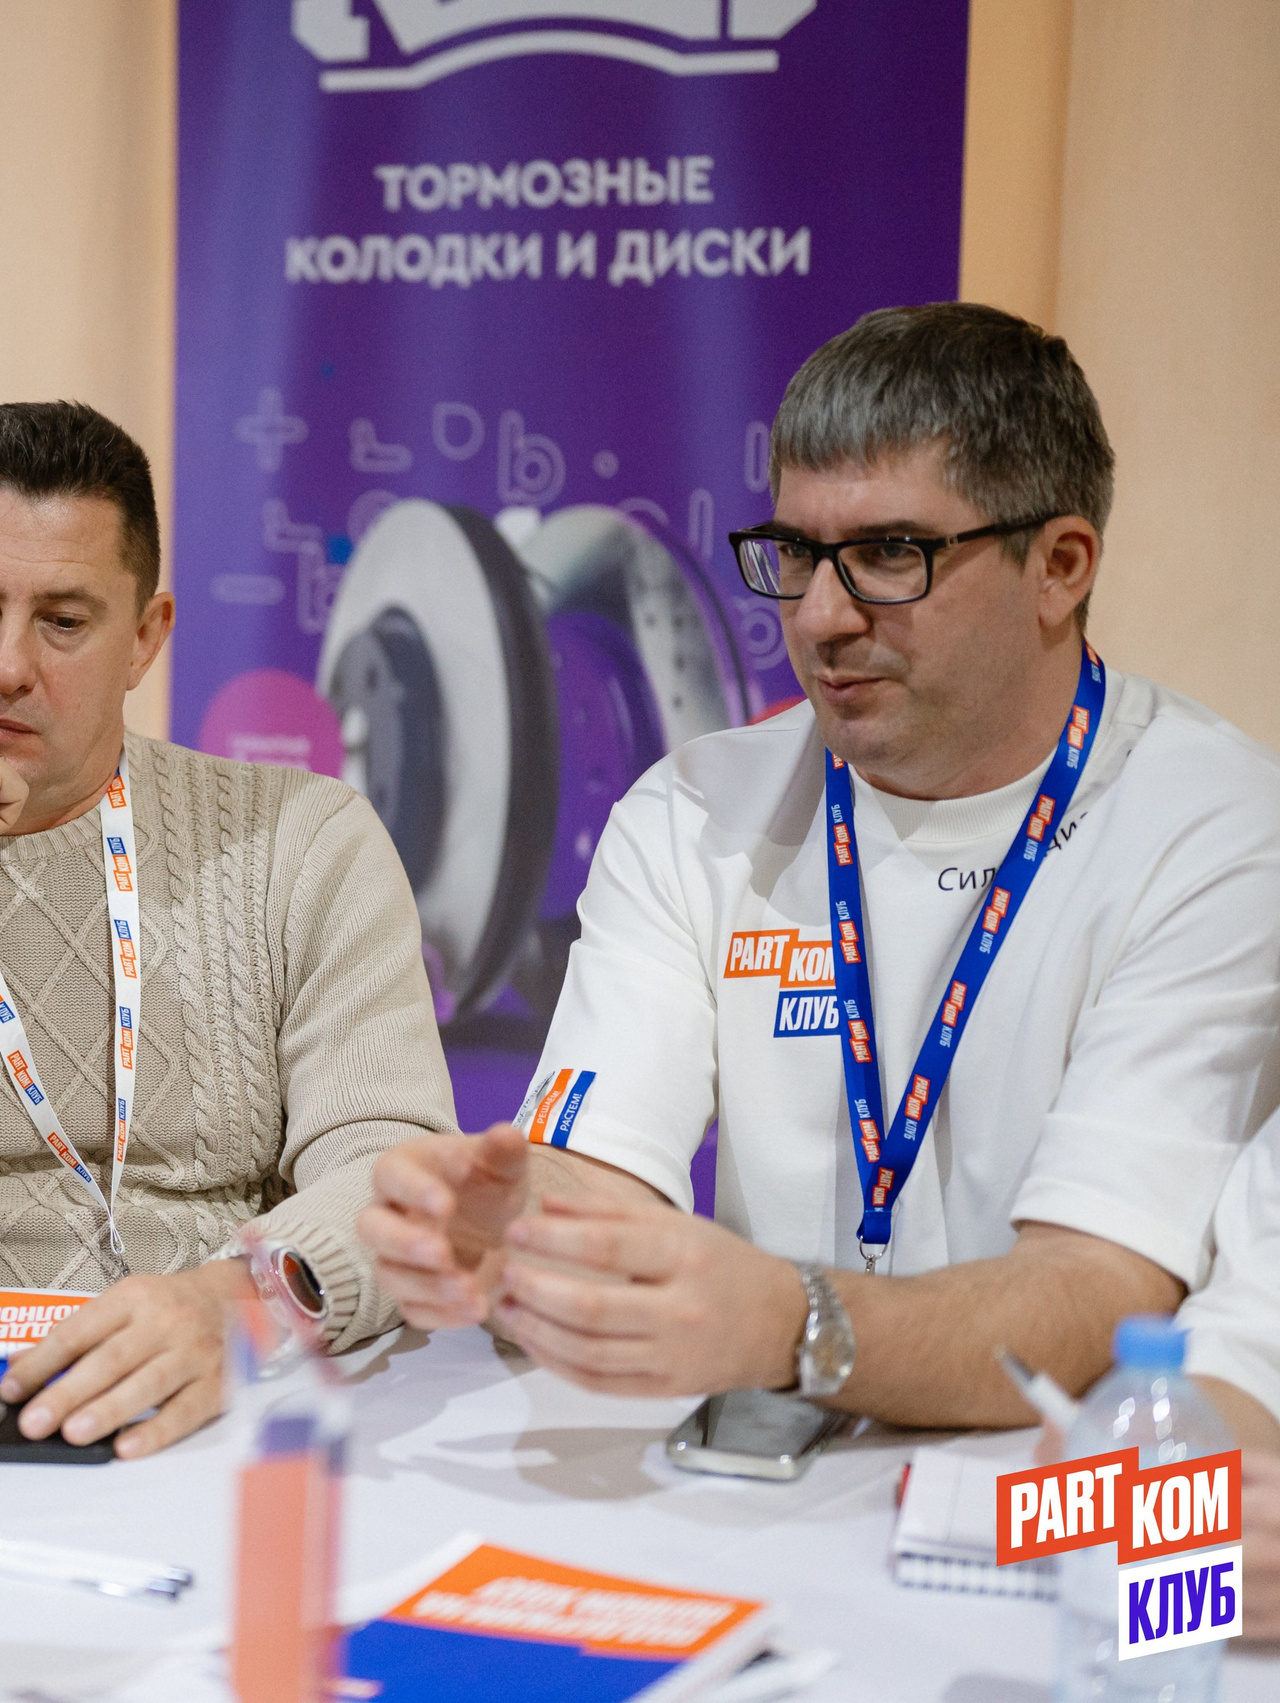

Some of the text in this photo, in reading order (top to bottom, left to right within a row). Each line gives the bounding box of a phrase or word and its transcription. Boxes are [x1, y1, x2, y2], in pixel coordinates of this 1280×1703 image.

[374, 155, 715, 212] ТОРМОЗНЫЕ
[285, 226, 811, 289] КОЛОДКИ И ДИСКИ
[836, 845, 851, 864] PART
[730, 935, 790, 972] PART
[842, 942, 859, 962] PART
[779, 996, 840, 1031] КЛУБ
[852, 1041, 870, 1061] PART
[560, 1093, 583, 1132] РАСТЕМ!
[49, 1135, 66, 1152] PART
